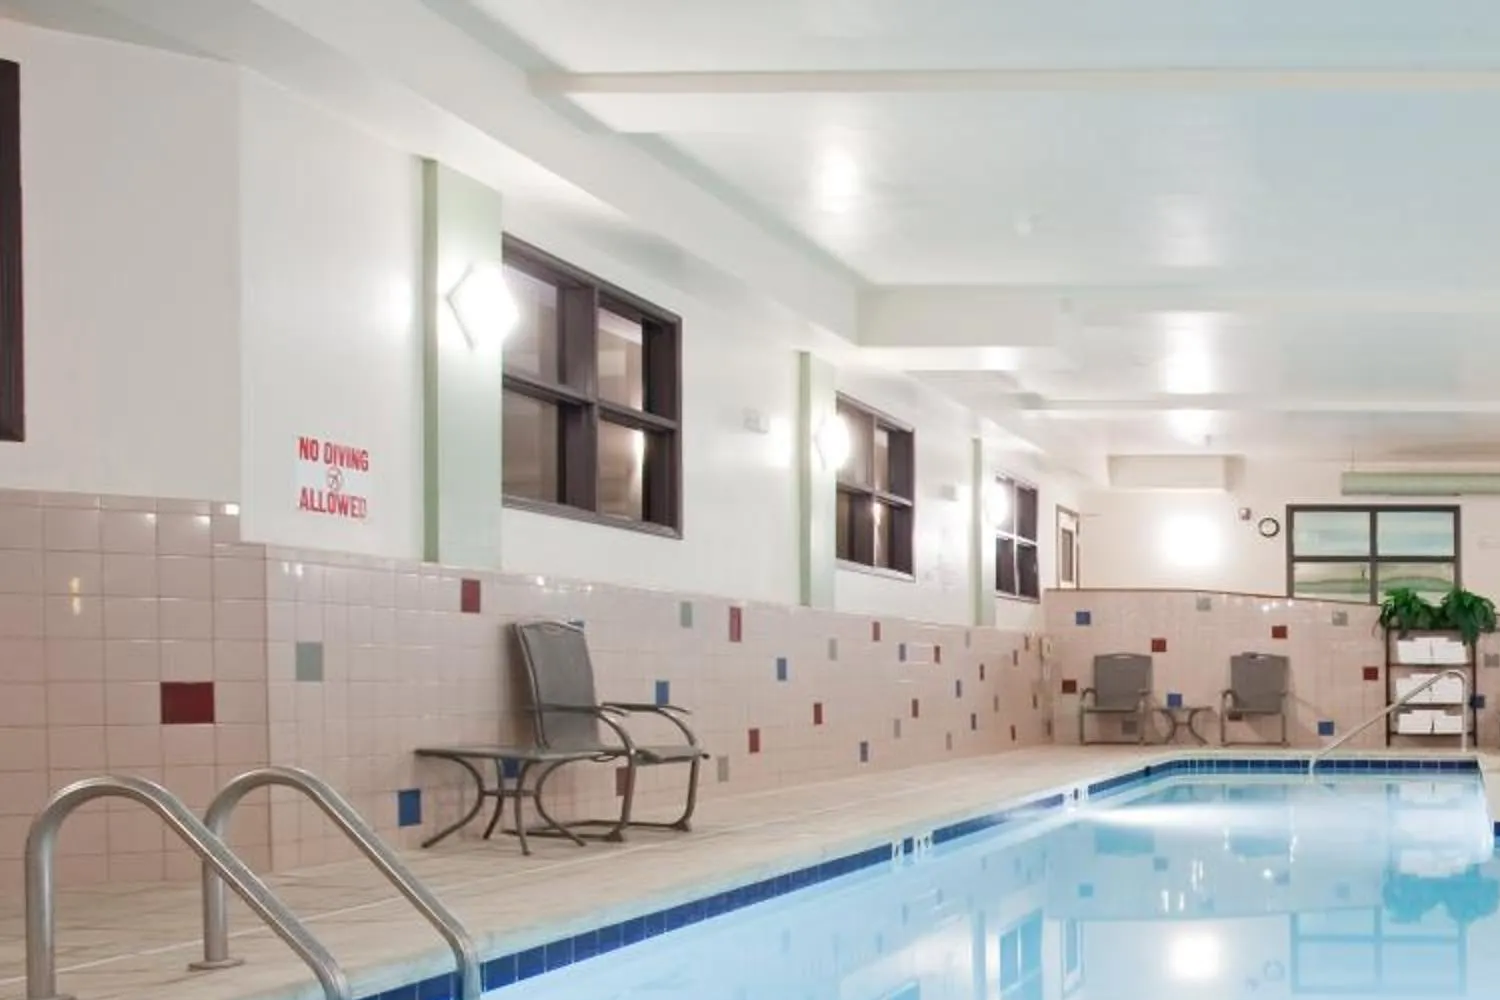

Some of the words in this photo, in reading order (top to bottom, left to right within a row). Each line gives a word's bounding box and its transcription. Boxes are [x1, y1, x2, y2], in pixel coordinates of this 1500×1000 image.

[298, 436, 319, 462] NO
[323, 442, 369, 472] DIVING
[299, 486, 367, 518] ALLOWED
